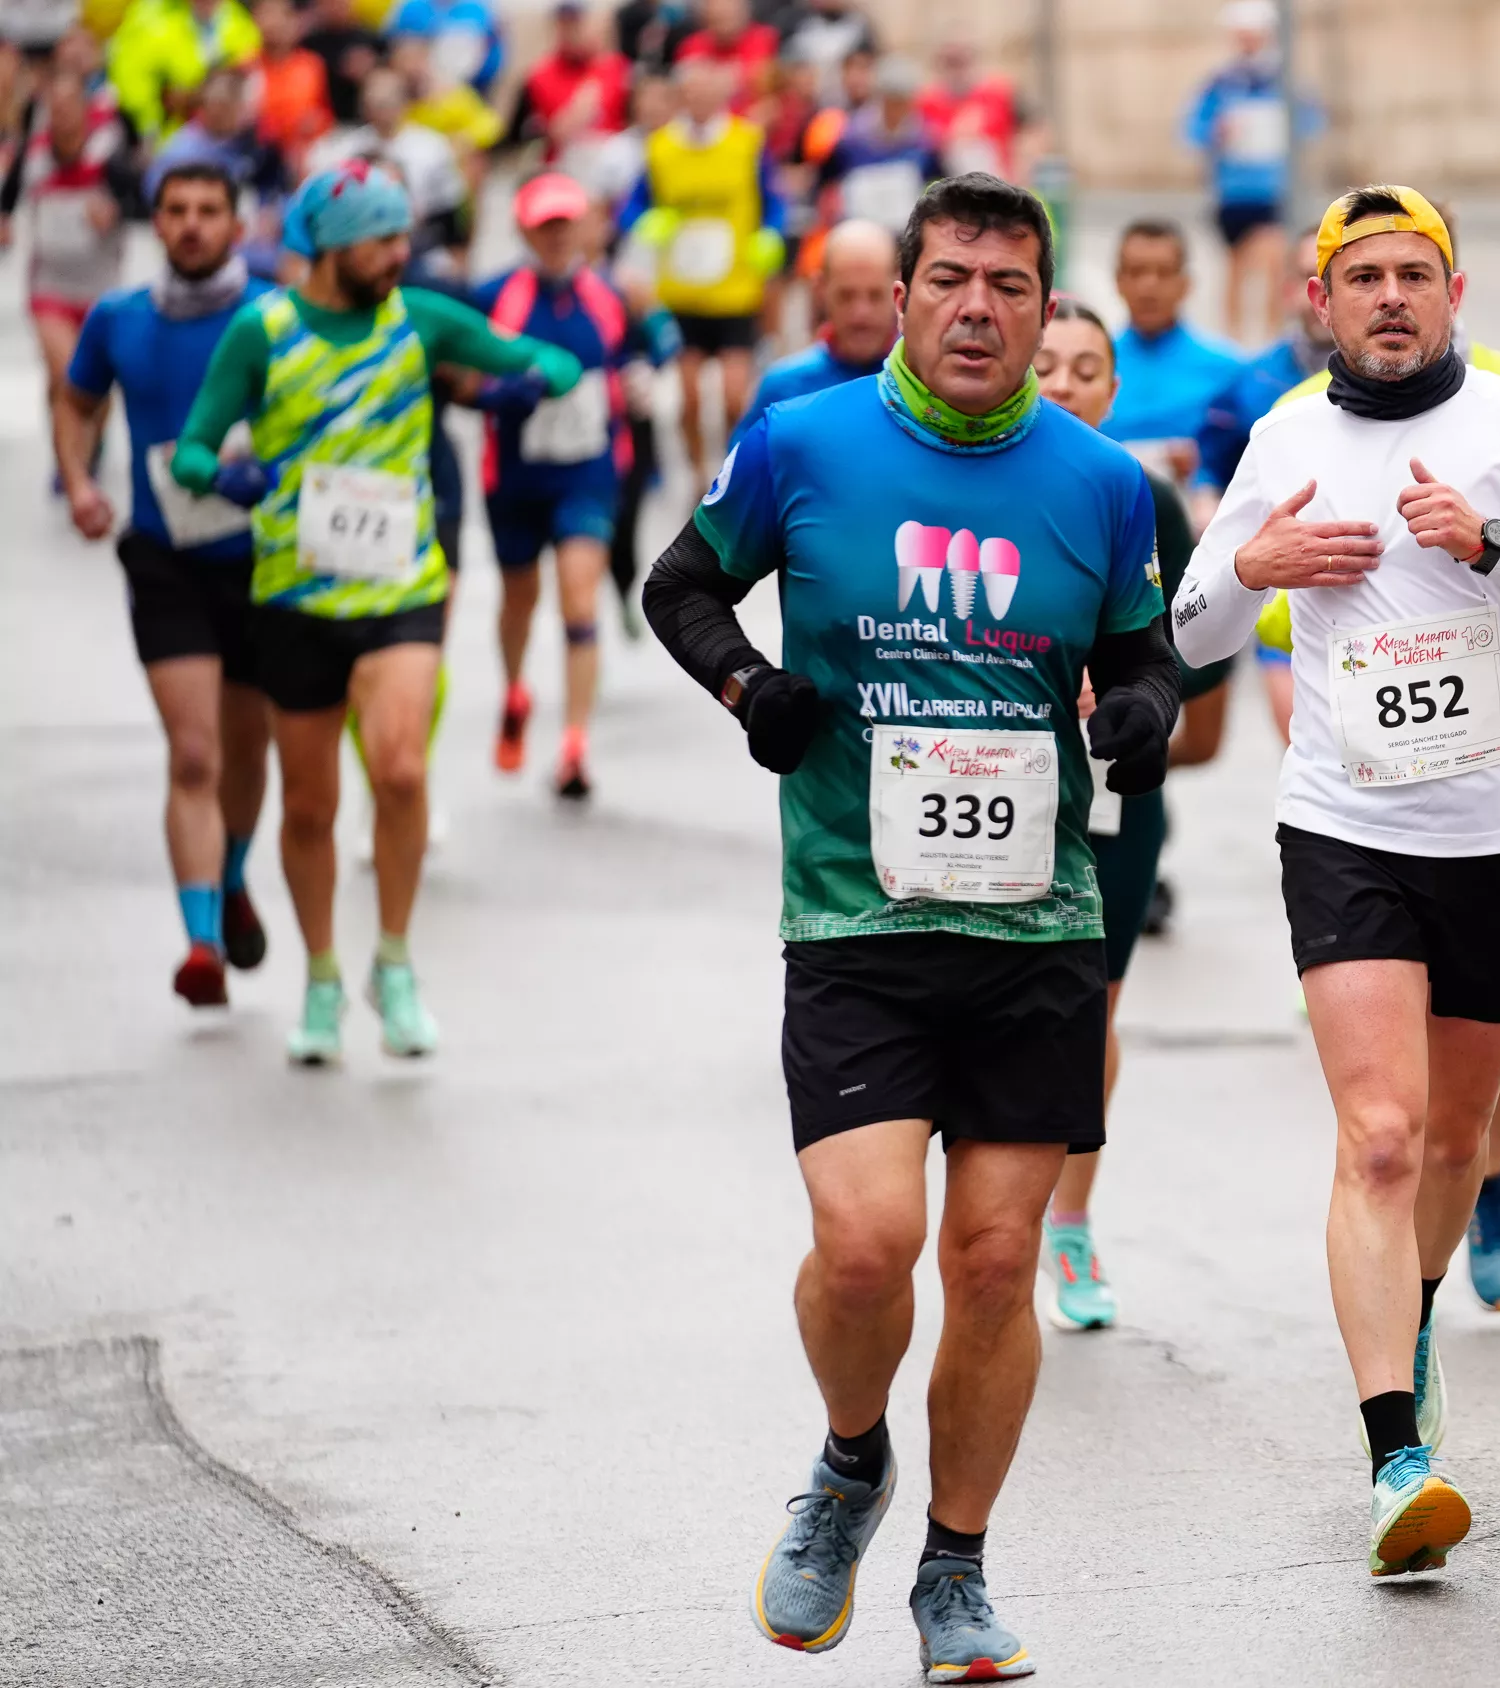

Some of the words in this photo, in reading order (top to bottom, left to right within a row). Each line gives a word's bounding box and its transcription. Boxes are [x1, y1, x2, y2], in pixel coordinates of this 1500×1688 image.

[857, 615, 949, 643] Dental
[966, 619, 1052, 655] Luque
[1415, 629, 1458, 645] MARATÓN
[875, 648, 911, 660] Centro
[952, 650, 984, 664] Dental
[1394, 647, 1449, 666] LUCENA
[857, 682, 910, 718] XVII
[909, 700, 988, 717] CARRERA
[992, 702, 1053, 719] POPULAR
[1376, 675, 1470, 728] 852
[1388, 737, 1410, 748] SERGIO
[1439, 729, 1468, 740] DELGADO
[1414, 743, 1446, 753] M-Hombre
[949, 763, 1006, 779] LUCENA
[918, 792, 1015, 841] 339
